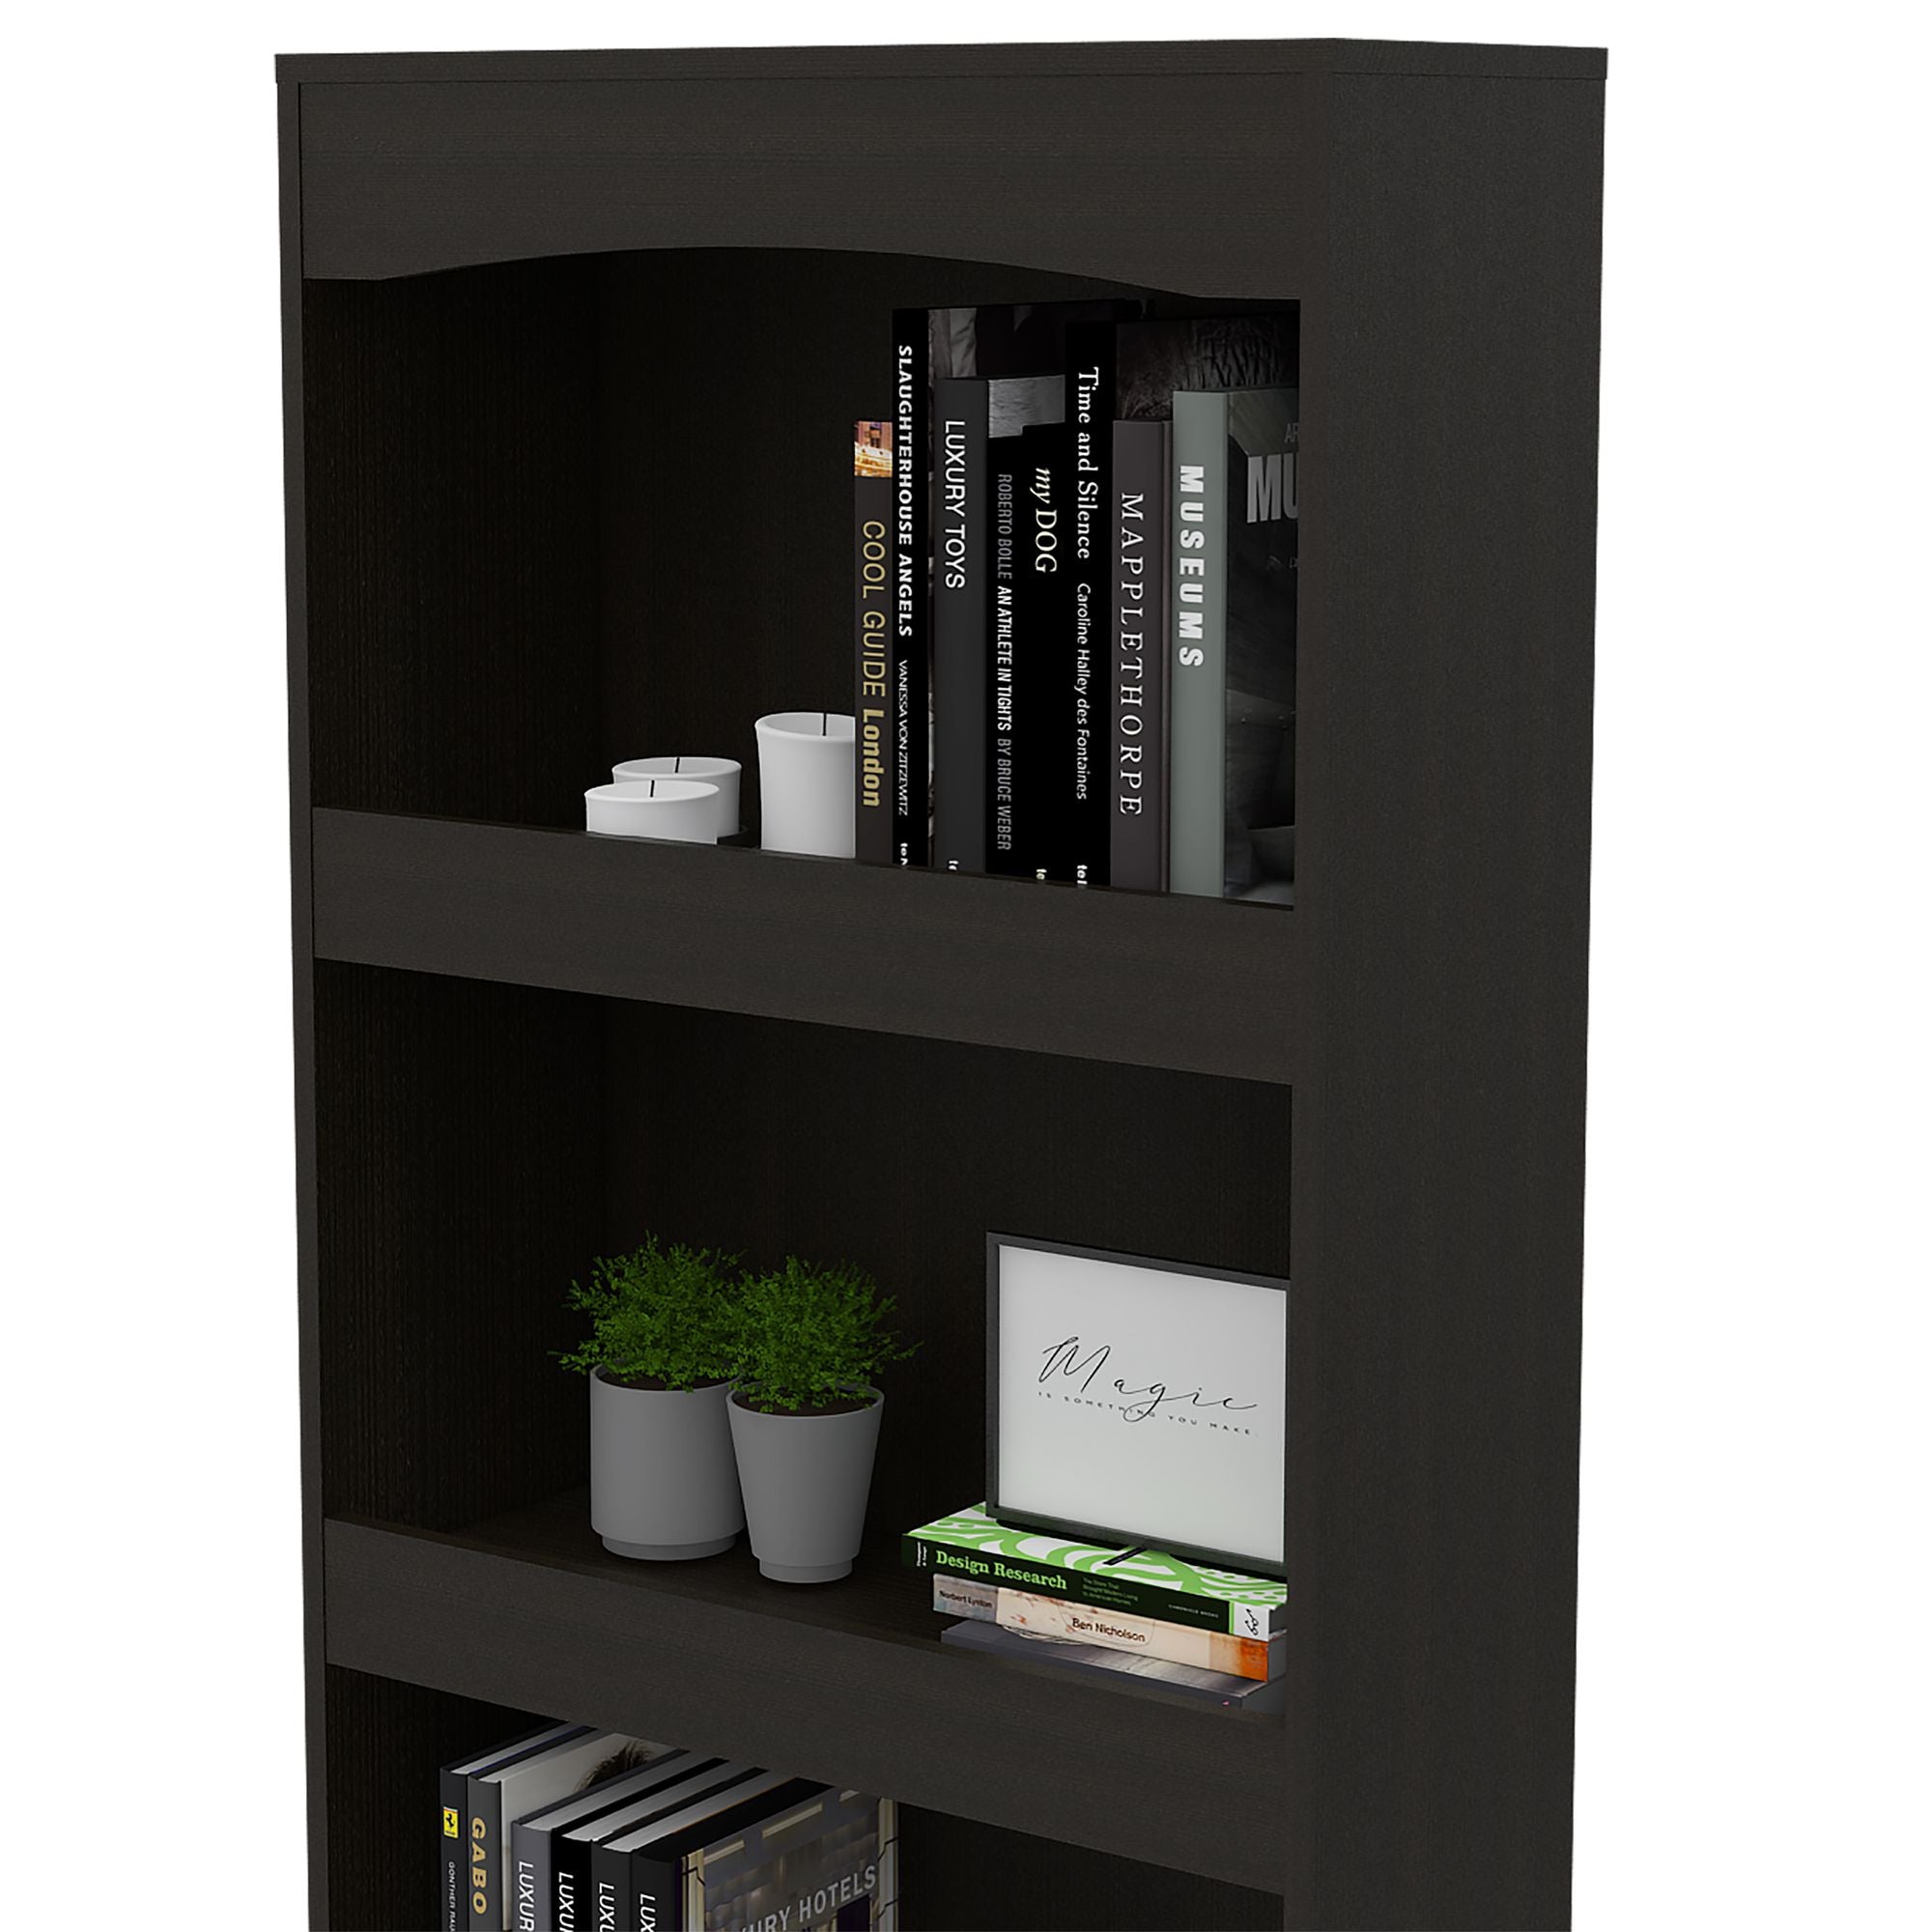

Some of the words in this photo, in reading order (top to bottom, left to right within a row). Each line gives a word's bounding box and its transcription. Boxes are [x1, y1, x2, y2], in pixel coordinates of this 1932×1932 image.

[1077, 366, 1099, 424] Time
[898, 345, 913, 545] SLAUGHTERHOUSE
[945, 420, 966, 518] LUXURY
[1077, 432, 1099, 471] and
[997, 473, 1013, 535] ROBERTO
[1029, 467, 1051, 505] my
[1035, 508, 1058, 573] DOG
[1077, 480, 1099, 559] Silence
[863, 521, 886, 599] COOL
[945, 519, 966, 588] TOYS
[997, 538, 1012, 579] BOLLE
[1179, 466, 1205, 667] MUSEUMS
[898, 553, 913, 637] ANGELS
[997, 585, 1012, 606] AN
[1076, 582, 1092, 645] Caroline
[863, 611, 886, 697] GUIDE
[997, 607, 1012, 665] ATHLETE
[1120, 492, 1144, 815] MAPPLETHORPE
[898, 659, 908, 718] VANESSA
[997, 667, 1012, 682] IN
[1073, 648, 1092, 696] Halley
[898, 719, 908, 751] VON
[997, 685, 1012, 731] TIGHTS
[1076, 697, 1091, 724] des
[863, 708, 885, 807] London
[997, 738, 1012, 756] BY
[1076, 728, 1091, 800] Fontaines
[997, 758, 1012, 802] BRUCE
[997, 805, 1012, 850] WEBER
[1038, 1337, 1258, 1422] Magic
[1167, 1414, 1198, 1426] YOU
[935, 1549, 990, 1575] Design
[993, 1562, 1067, 1590] Research
[1071, 1617, 1094, 1632] Ben
[1095, 1622, 1146, 1642] Nicholson
[471, 1816, 487, 1915] GABO
[798, 1864, 877, 1923] HOTELS
